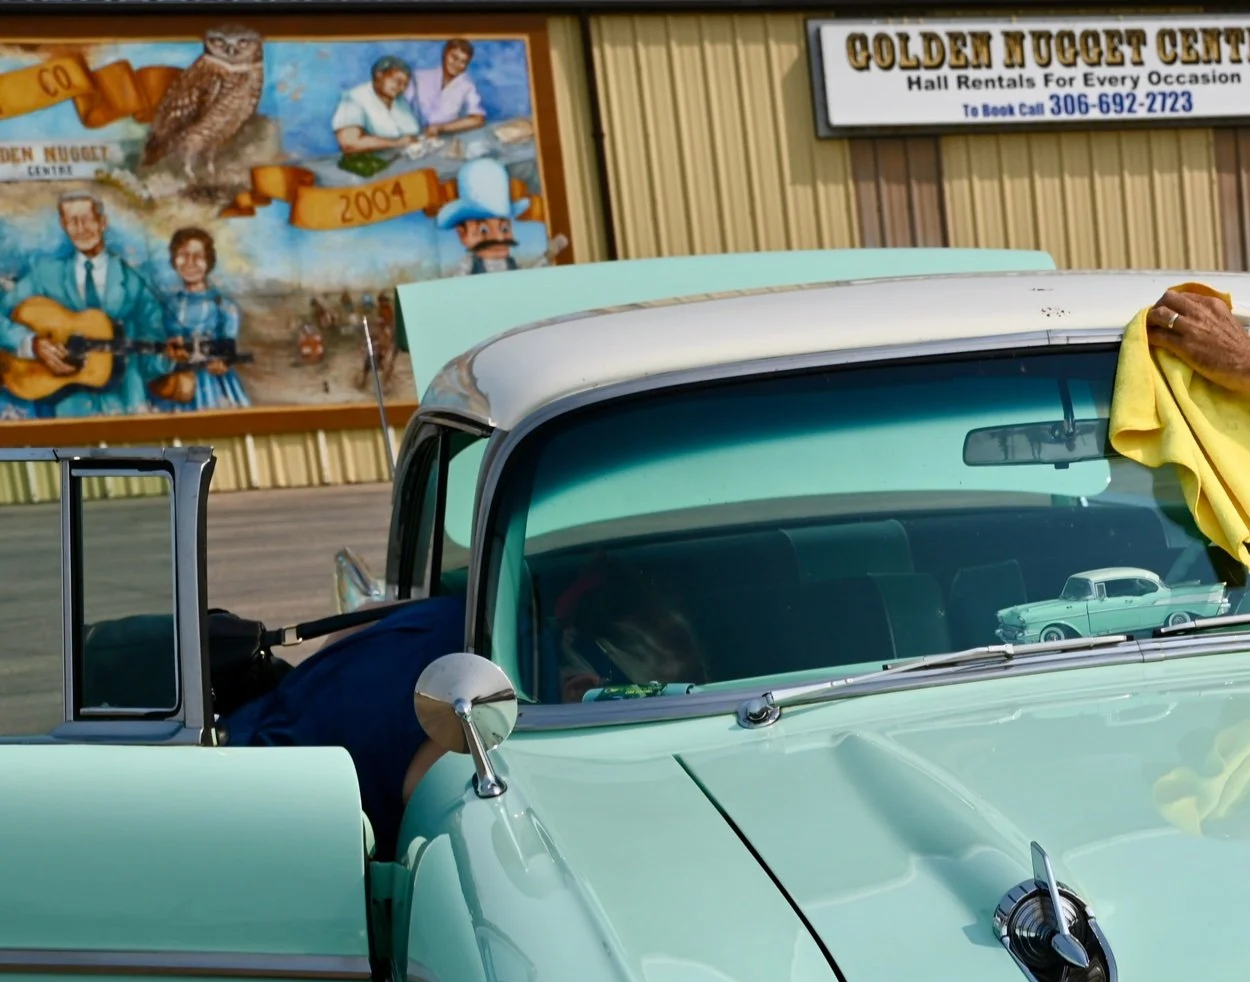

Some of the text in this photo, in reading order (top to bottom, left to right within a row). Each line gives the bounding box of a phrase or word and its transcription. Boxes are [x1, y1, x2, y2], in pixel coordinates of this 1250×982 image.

[845, 31, 992, 71] GOLDEN
[1001, 29, 1148, 68] NUGGET
[907, 69, 1242, 91] Hall Rentals For Every Occasion
[963, 91, 1193, 118] To Book Call 306-692-2723
[44, 145, 108, 163] NUGGET
[339, 181, 407, 224] 2004
